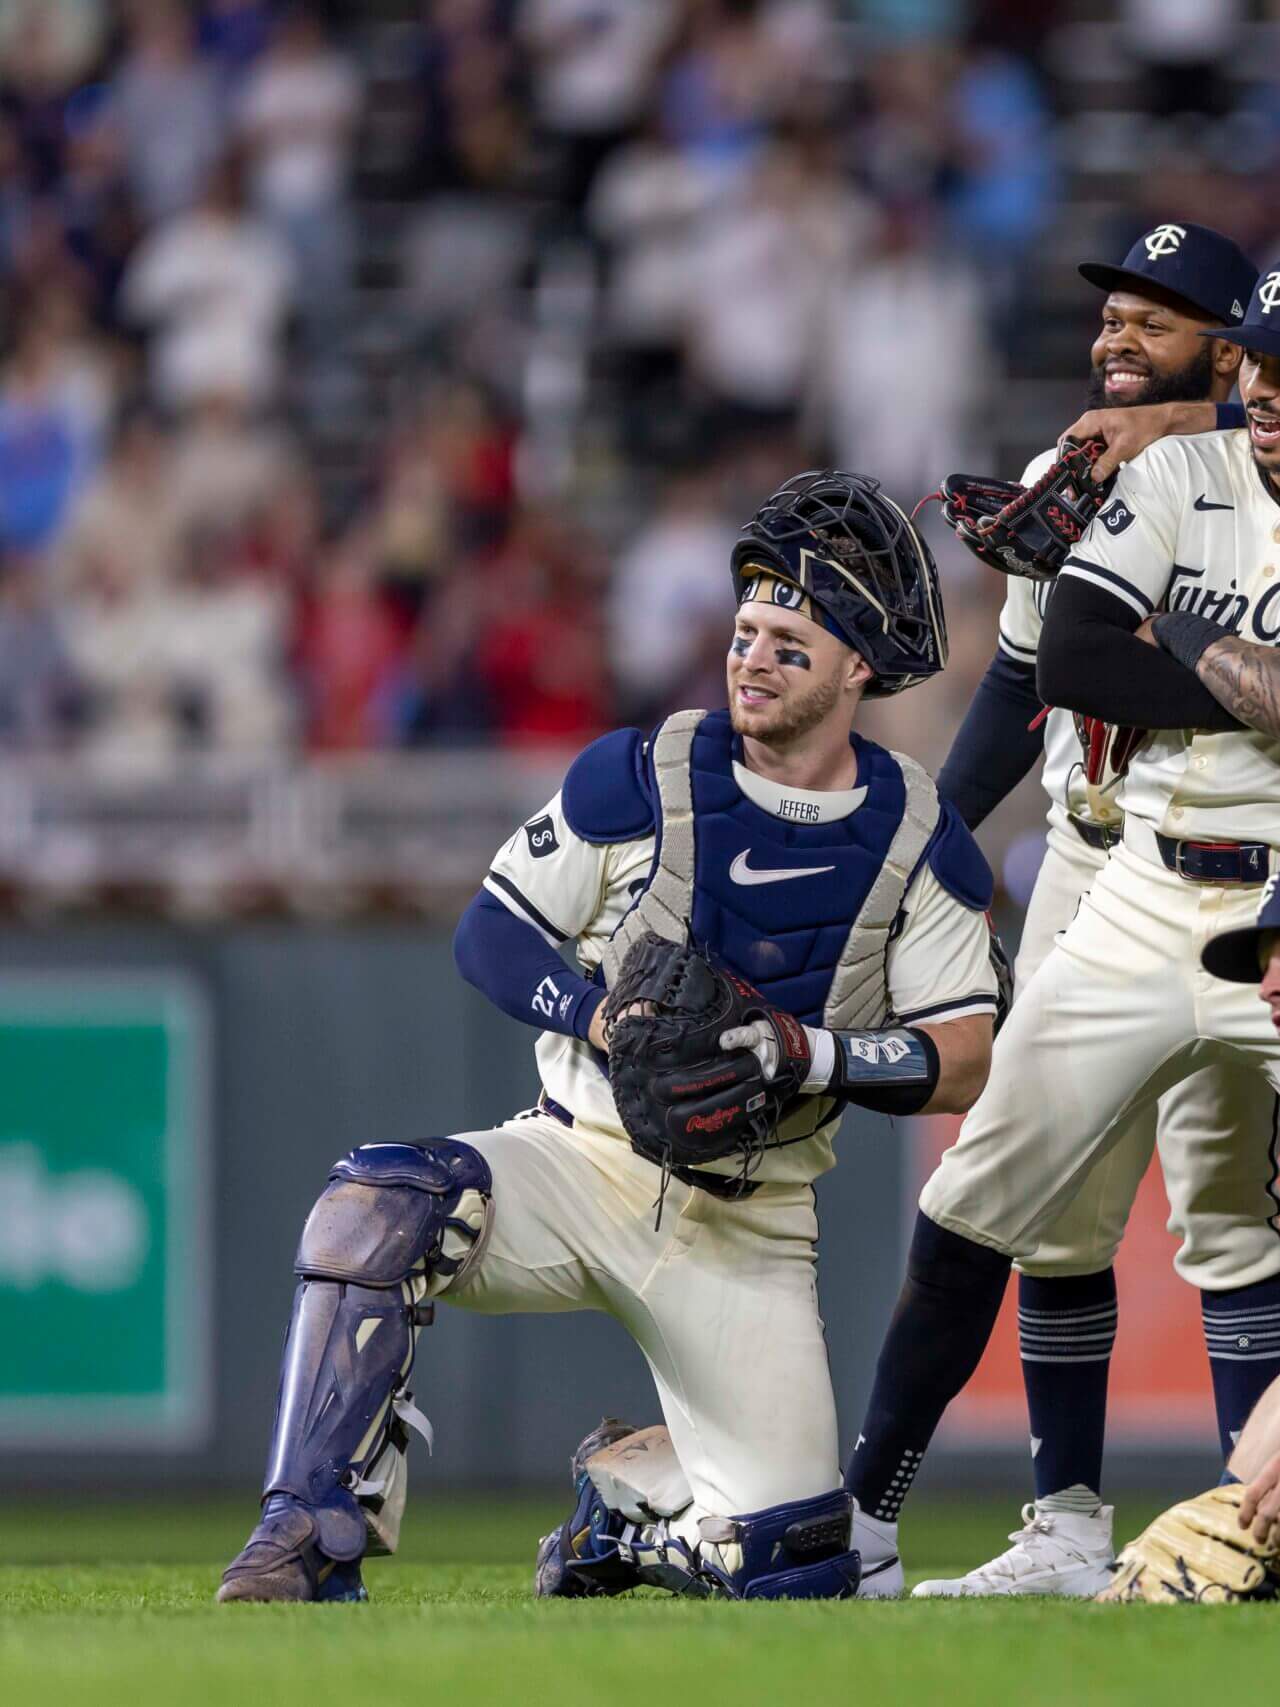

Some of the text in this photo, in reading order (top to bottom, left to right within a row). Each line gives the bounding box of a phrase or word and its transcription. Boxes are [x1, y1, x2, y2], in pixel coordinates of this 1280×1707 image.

[777, 799, 821, 822] JEFFERS
[1249, 849, 1259, 870] 4
[531, 975, 560, 1017] 27
